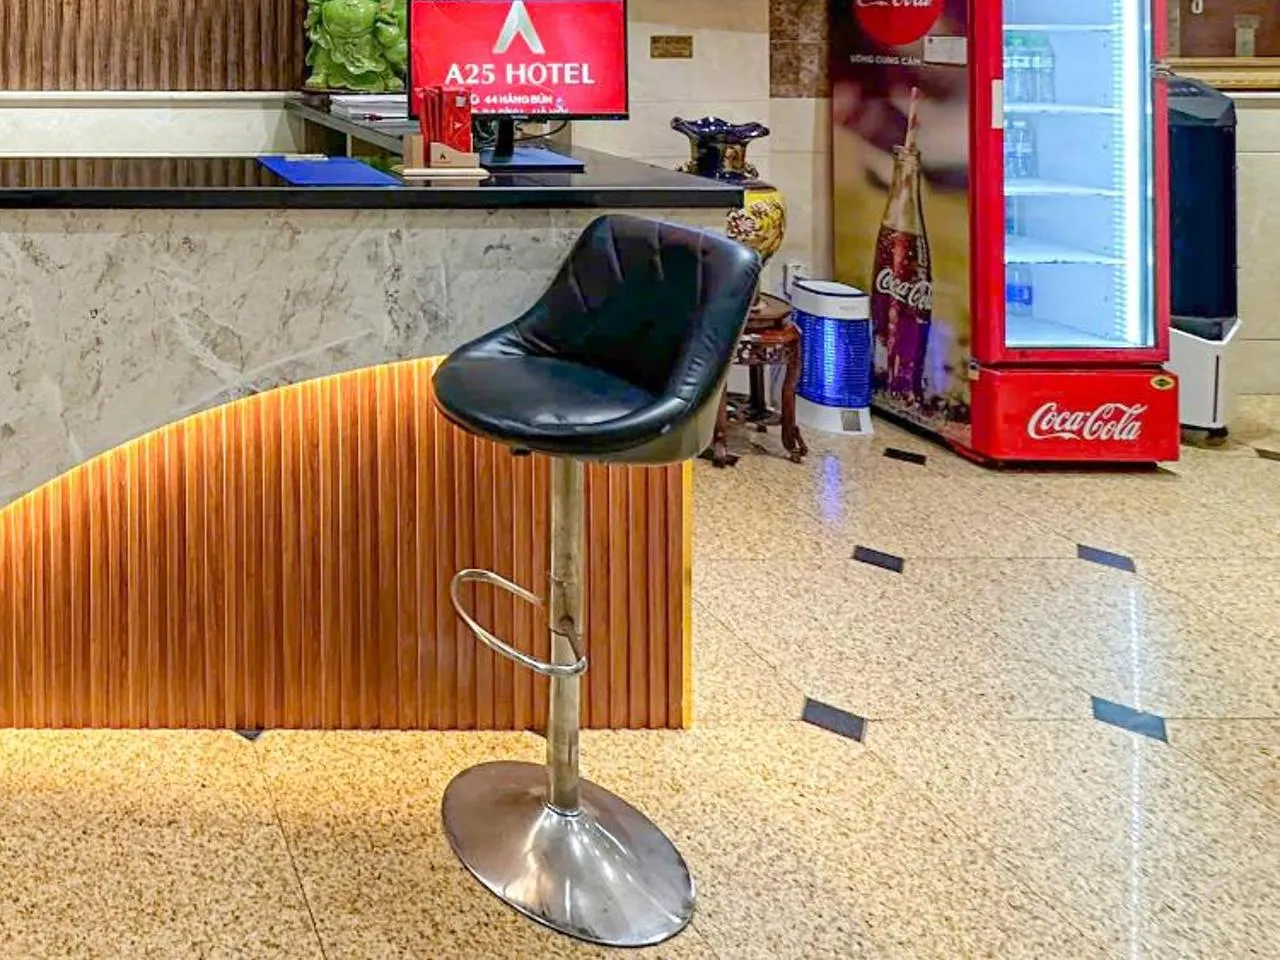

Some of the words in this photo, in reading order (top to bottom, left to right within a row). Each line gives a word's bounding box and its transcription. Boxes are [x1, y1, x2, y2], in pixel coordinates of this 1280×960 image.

[444, 63, 496, 85] A25
[506, 63, 596, 85] HOTEL
[484, 95, 498, 105] 44
[1027, 401, 1149, 441] Coca-Cola
